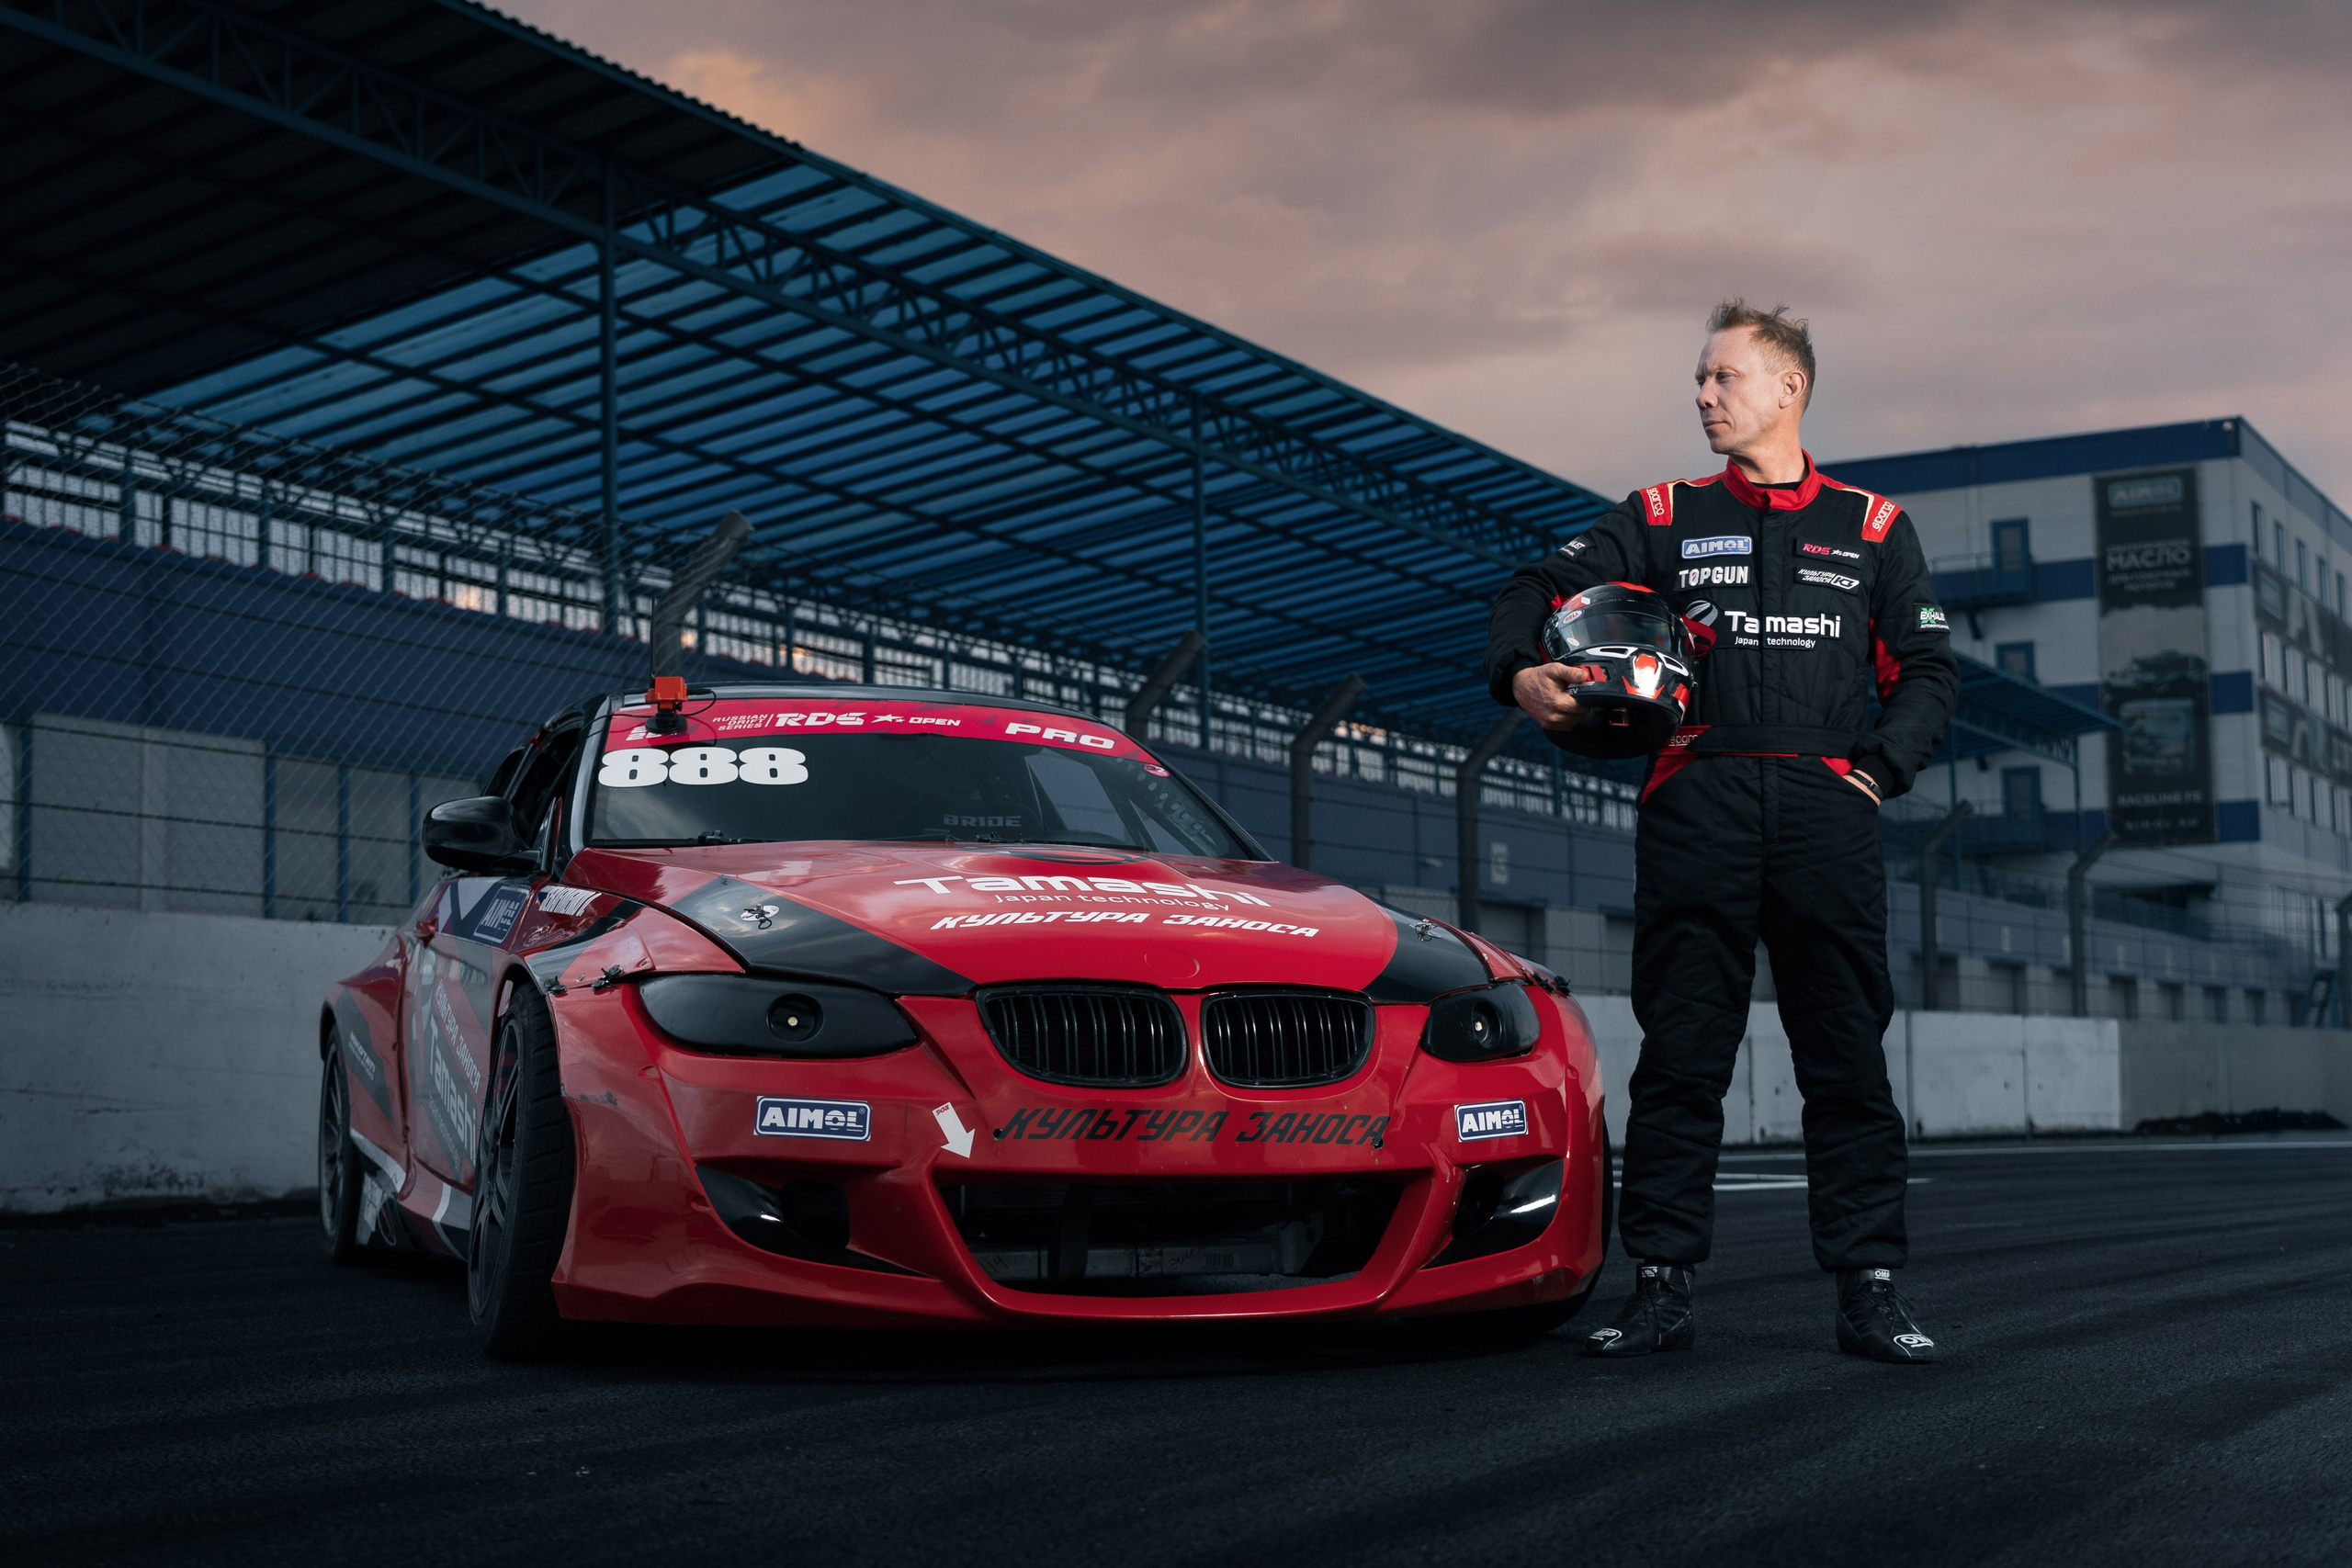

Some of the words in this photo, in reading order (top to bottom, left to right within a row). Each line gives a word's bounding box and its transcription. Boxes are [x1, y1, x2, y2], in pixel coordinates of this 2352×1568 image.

[1647, 488, 1664, 516] sparco
[1871, 501, 1894, 532] sparco
[1685, 540, 1747, 554] AIMOL
[1841, 551, 1860, 559] OPEN
[1679, 566, 1748, 588] TOPGUN
[1735, 636, 1758, 646] Japan
[1767, 637, 1816, 649] technology
[712, 714, 768, 724] RUSSIAN
[718, 723, 763, 731] SERIES
[728, 718, 765, 727] DRIFT
[909, 716, 961, 727] OPEN
[1004, 722, 1115, 750] PRO
[598, 747, 808, 787] 888
[943, 814, 1022, 827] BRIDE
[893, 875, 1272, 908] Tamashi
[995, 893, 1072, 904] Japan
[1081, 894, 1229, 911] technology
[930, 911, 1148, 930] КУЛЬТУРА
[1163, 914, 1320, 938] ЗАНОСА
[430, 1014, 476, 1167] Tamashi
[761, 1107, 864, 1132] AIMOL
[1000, 1108, 1230, 1142] КУЛЬТУРА
[1236, 1111, 1390, 1145] ЗАНОСА
[1462, 1109, 1524, 1134] AIMOL
[1874, 1269, 1891, 1279] OMP
